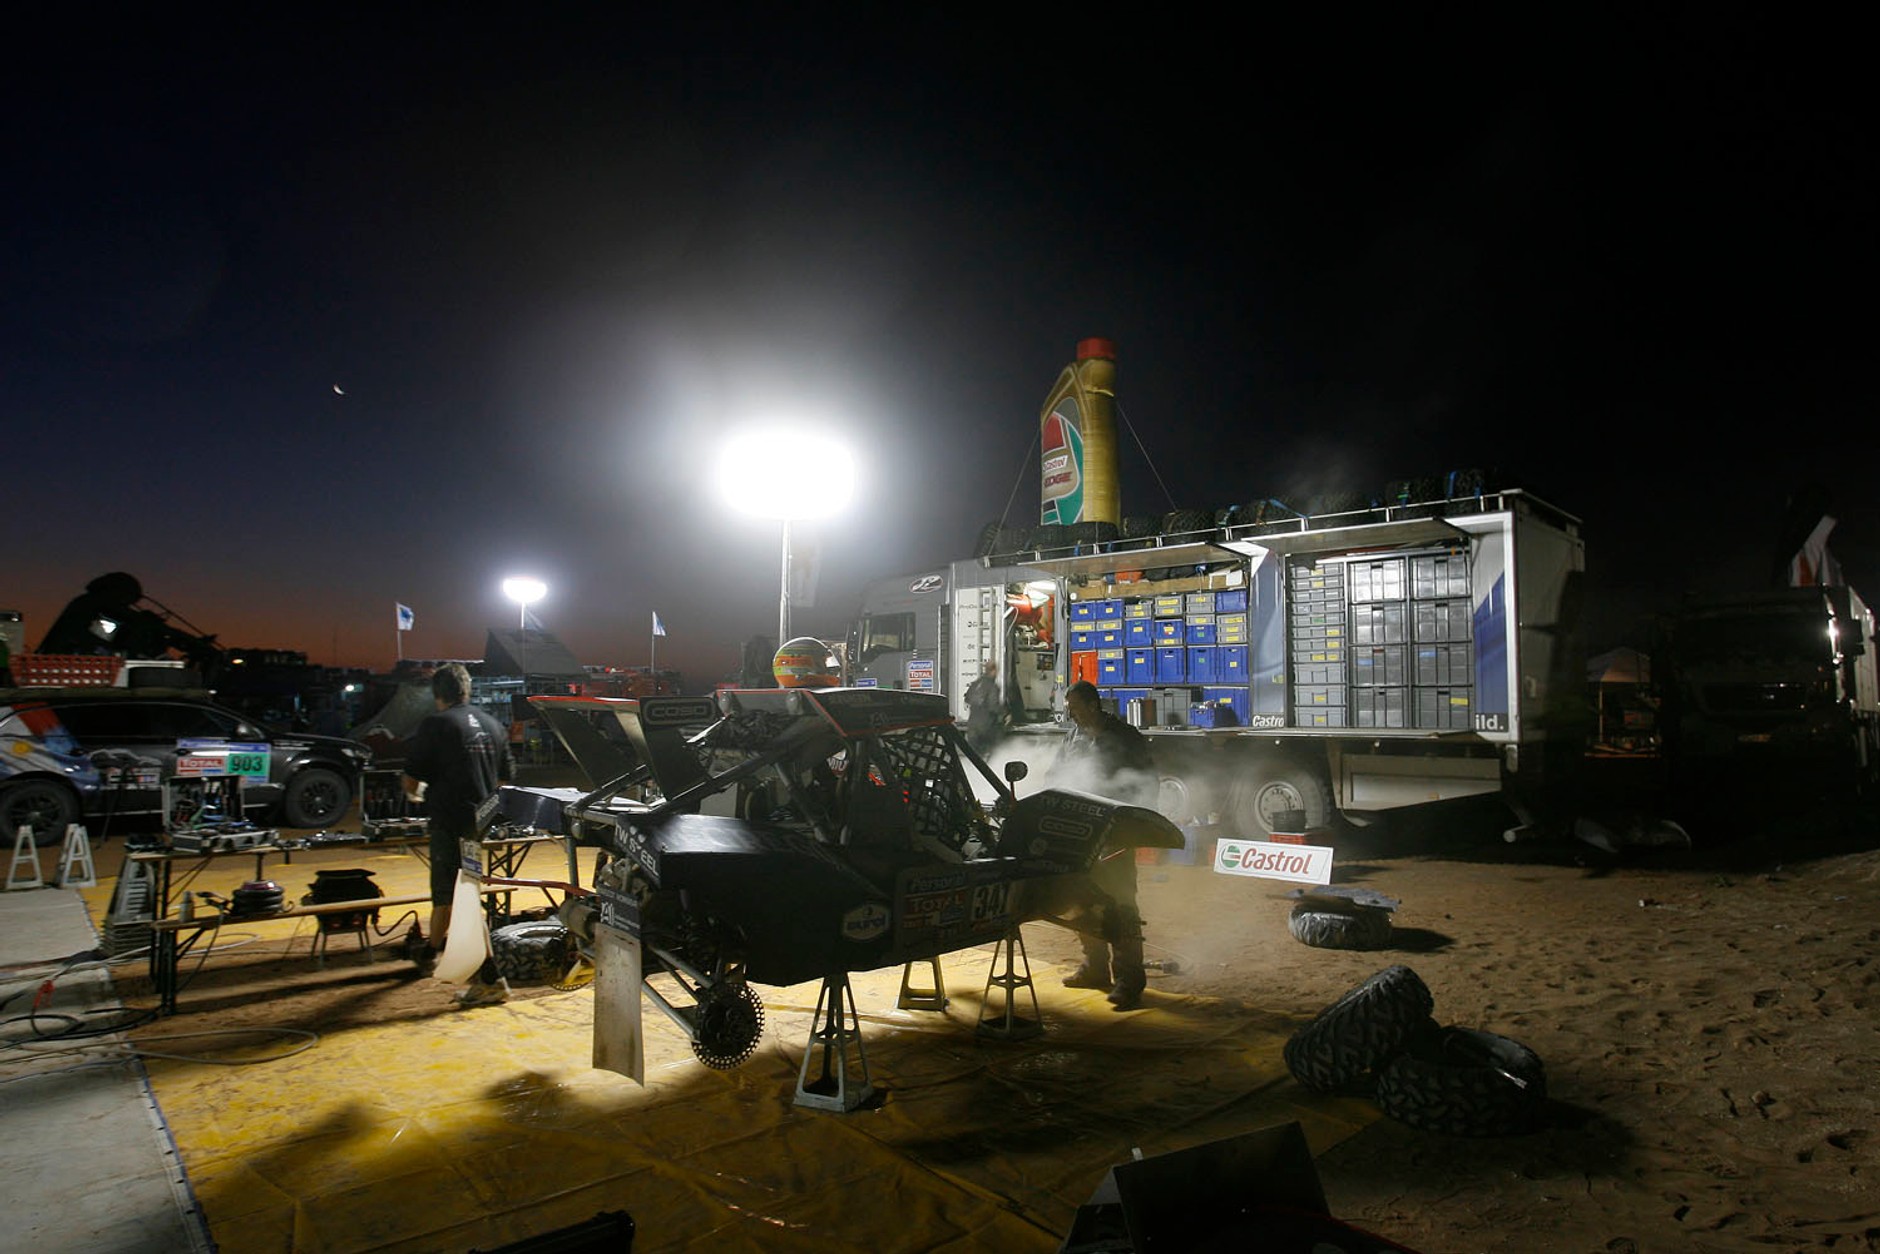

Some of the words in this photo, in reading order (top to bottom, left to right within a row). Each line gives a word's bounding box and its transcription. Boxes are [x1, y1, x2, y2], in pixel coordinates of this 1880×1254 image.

[182, 758, 223, 768] TOTAL
[232, 756, 263, 772] 903
[1241, 848, 1312, 875] Castrol
